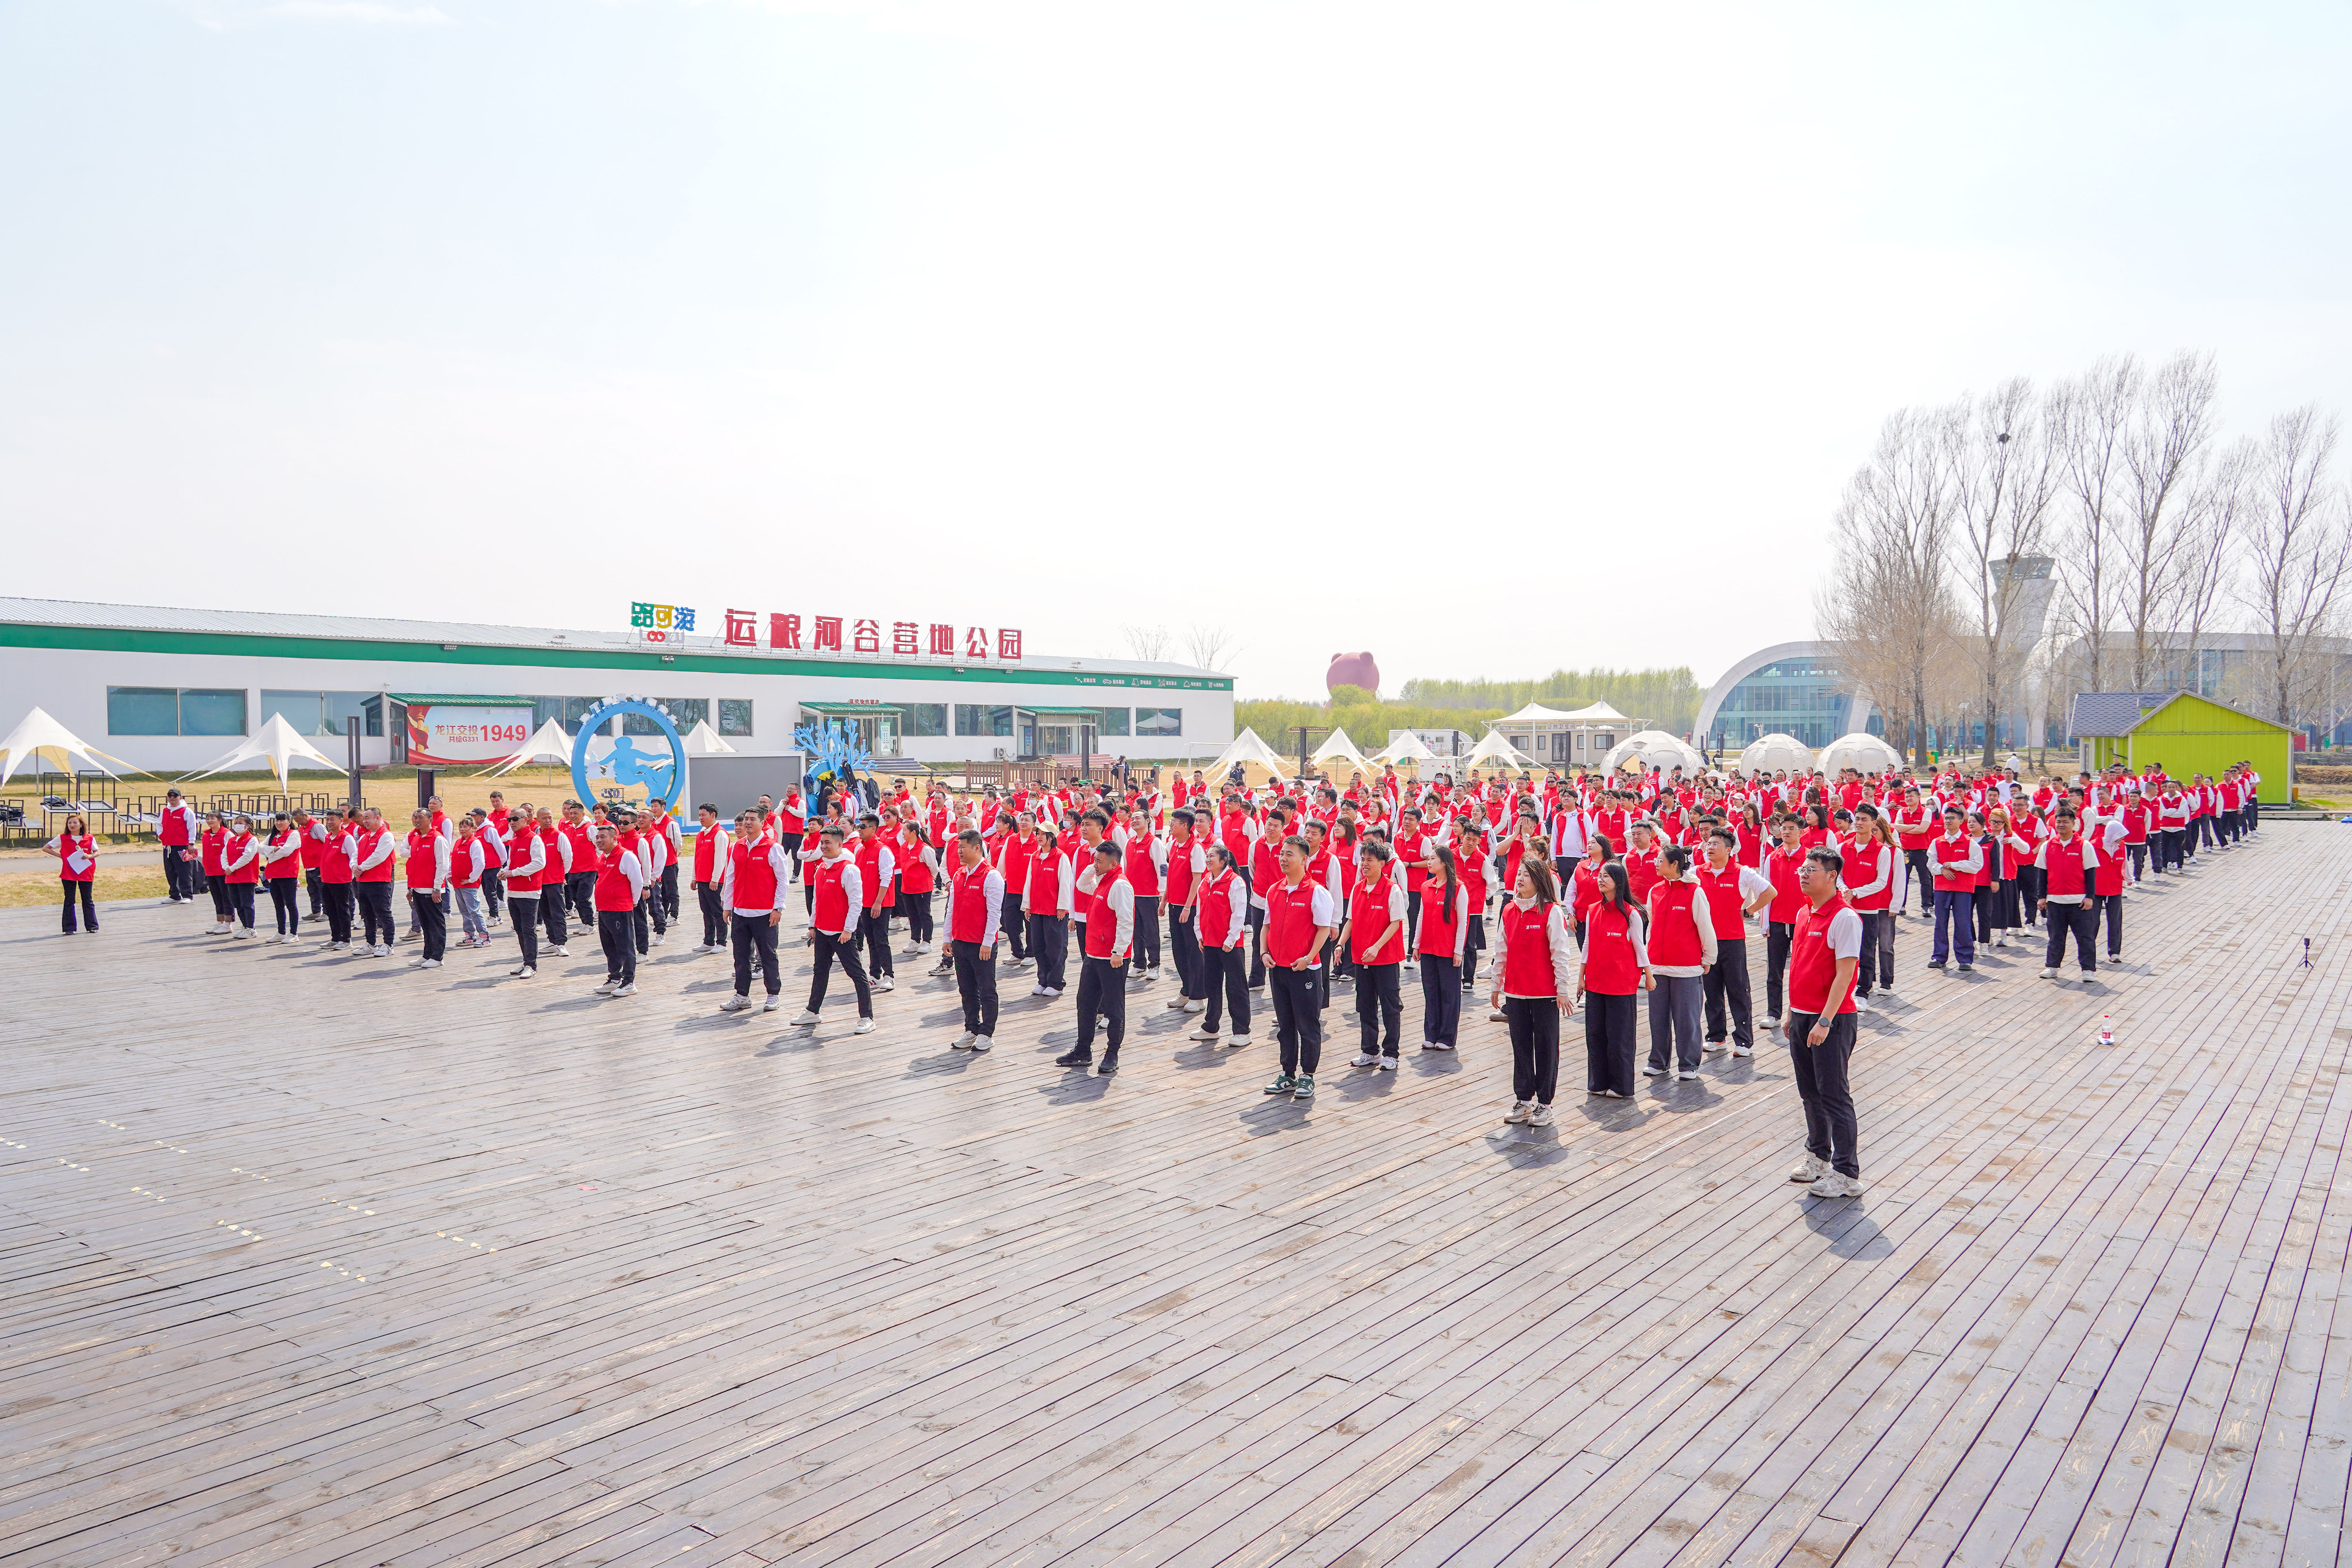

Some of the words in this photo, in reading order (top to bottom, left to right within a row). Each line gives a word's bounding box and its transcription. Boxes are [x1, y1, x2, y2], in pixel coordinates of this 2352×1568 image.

[632, 601, 695, 631] 路可游
[724, 608, 1022, 659] 运粮河谷营地公园
[435, 725, 478, 735] 龙江交投
[480, 725, 526, 741] 1949
